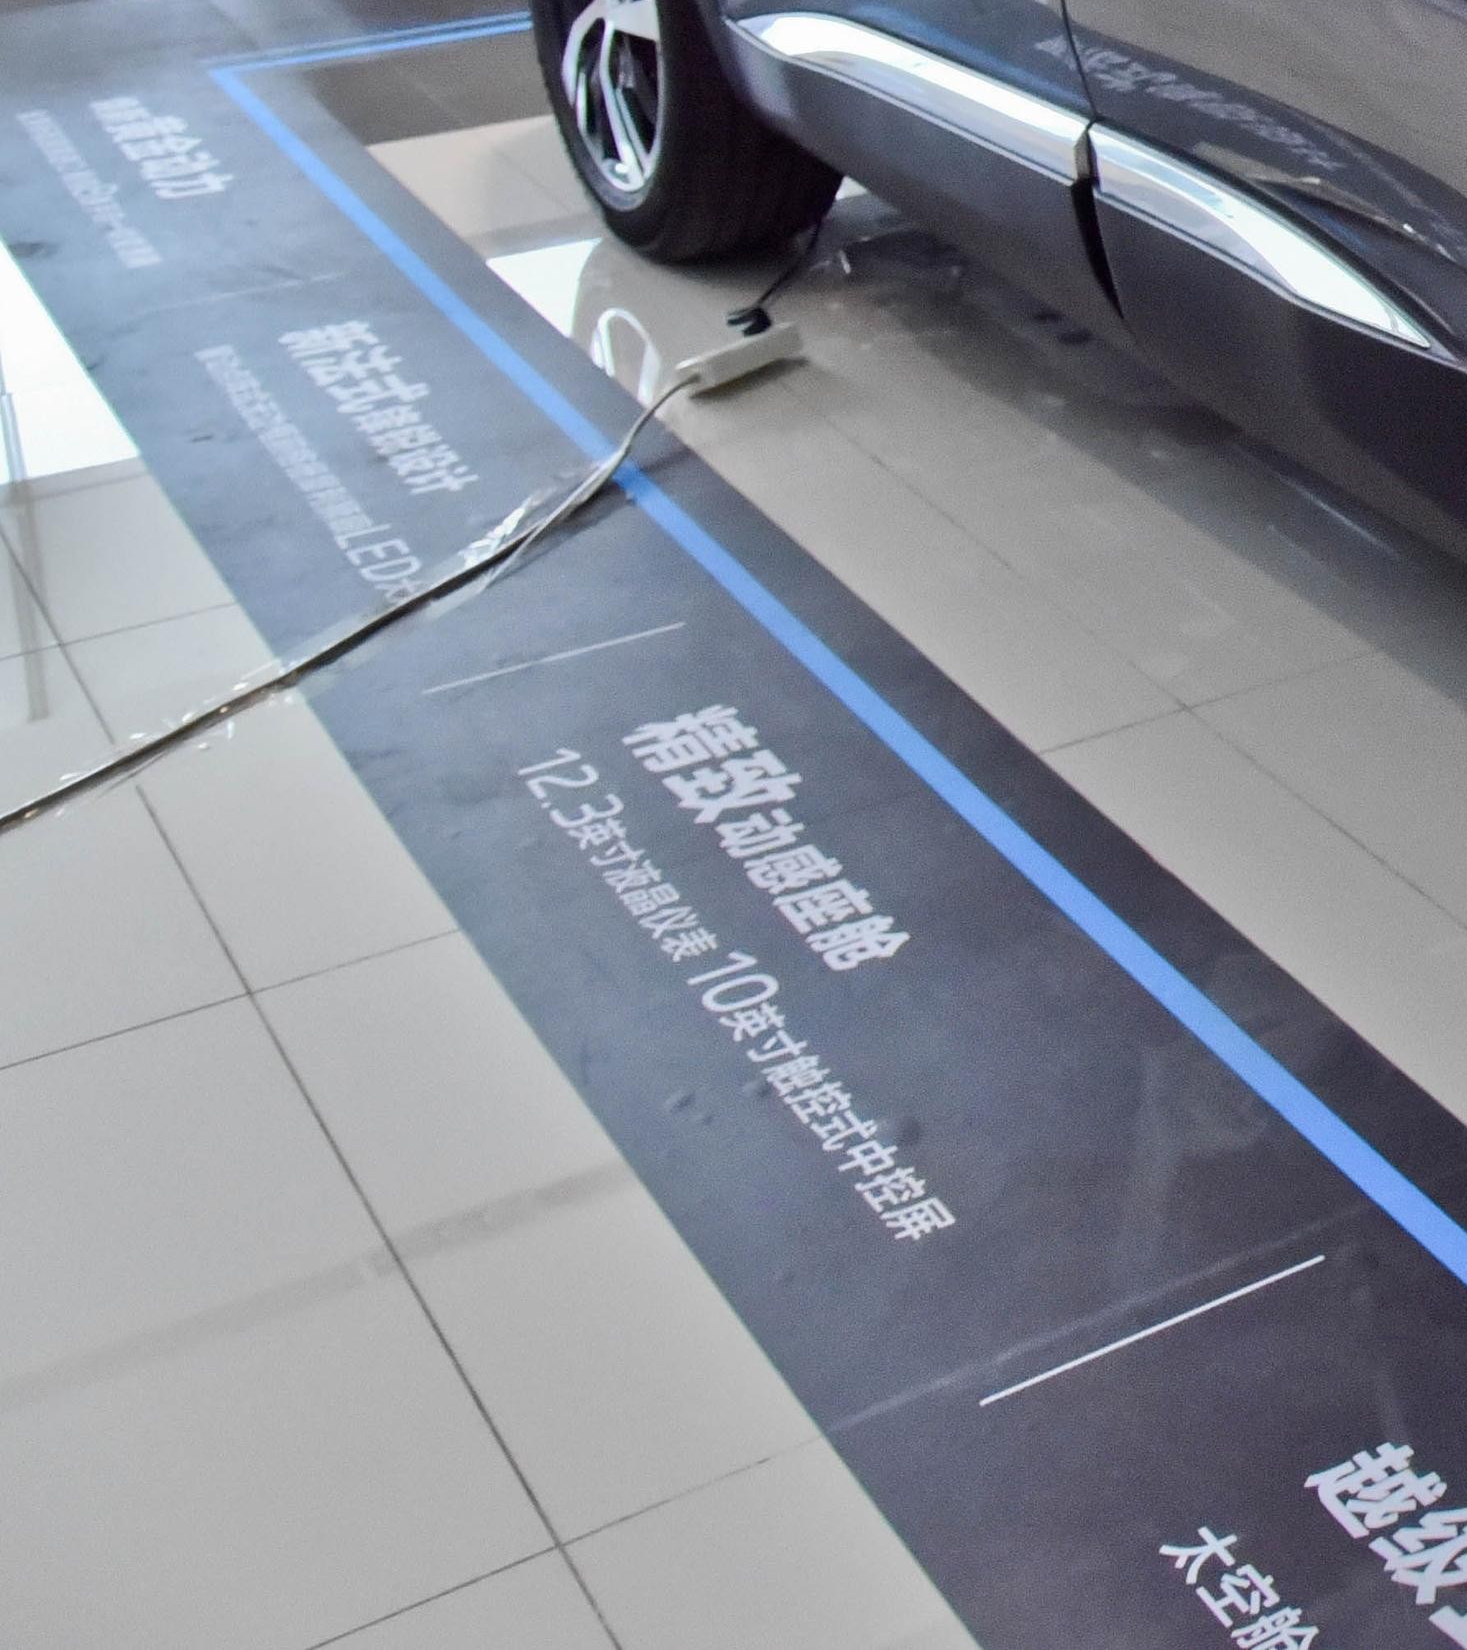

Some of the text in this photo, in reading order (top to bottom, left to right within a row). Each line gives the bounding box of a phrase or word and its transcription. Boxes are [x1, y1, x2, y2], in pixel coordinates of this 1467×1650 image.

[516, 747, 957, 1242] 12.3英寸液晶仪表 10英寸触控式中控屏
[622, 703, 911, 972] 精致动感座舱
